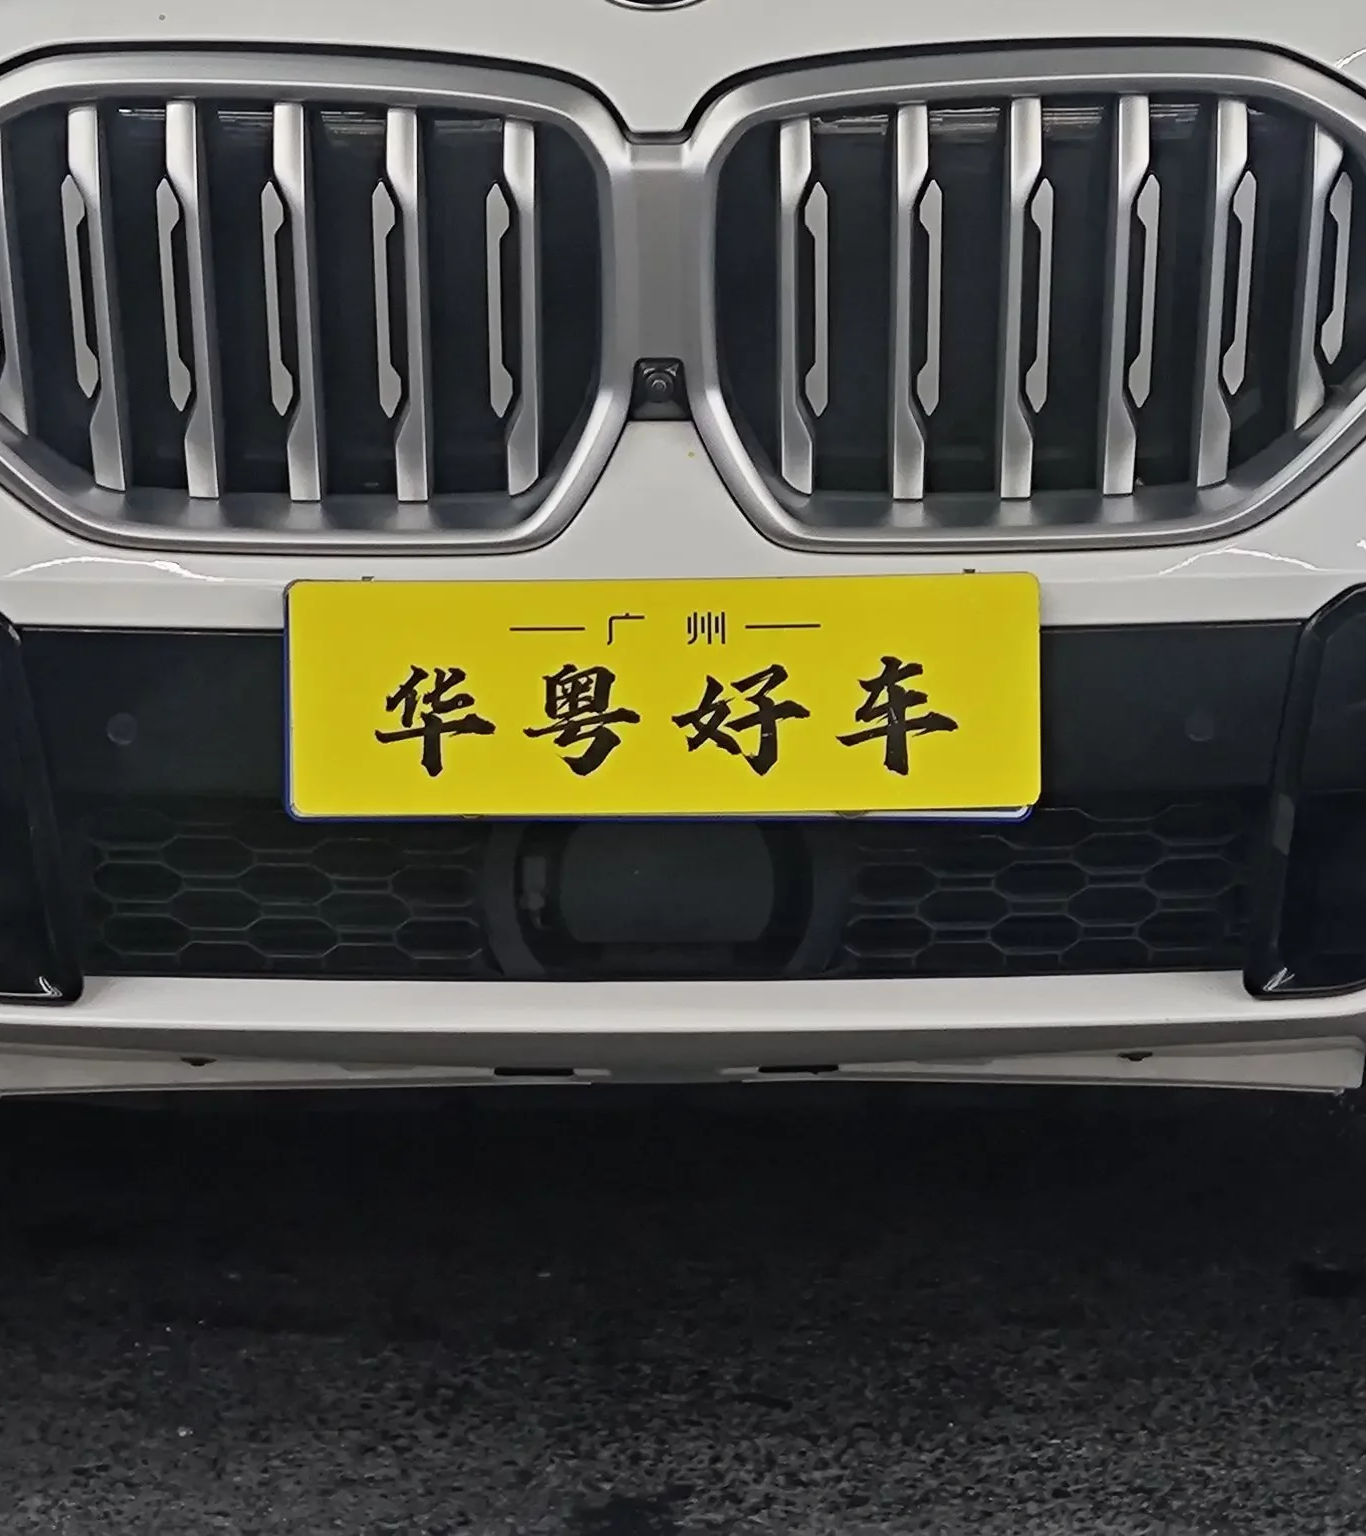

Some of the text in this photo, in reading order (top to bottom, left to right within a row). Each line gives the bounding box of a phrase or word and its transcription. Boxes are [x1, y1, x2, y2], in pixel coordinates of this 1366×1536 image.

[605, 610, 727, 647] 广州
[374, 655, 960, 777] 华粤好车
